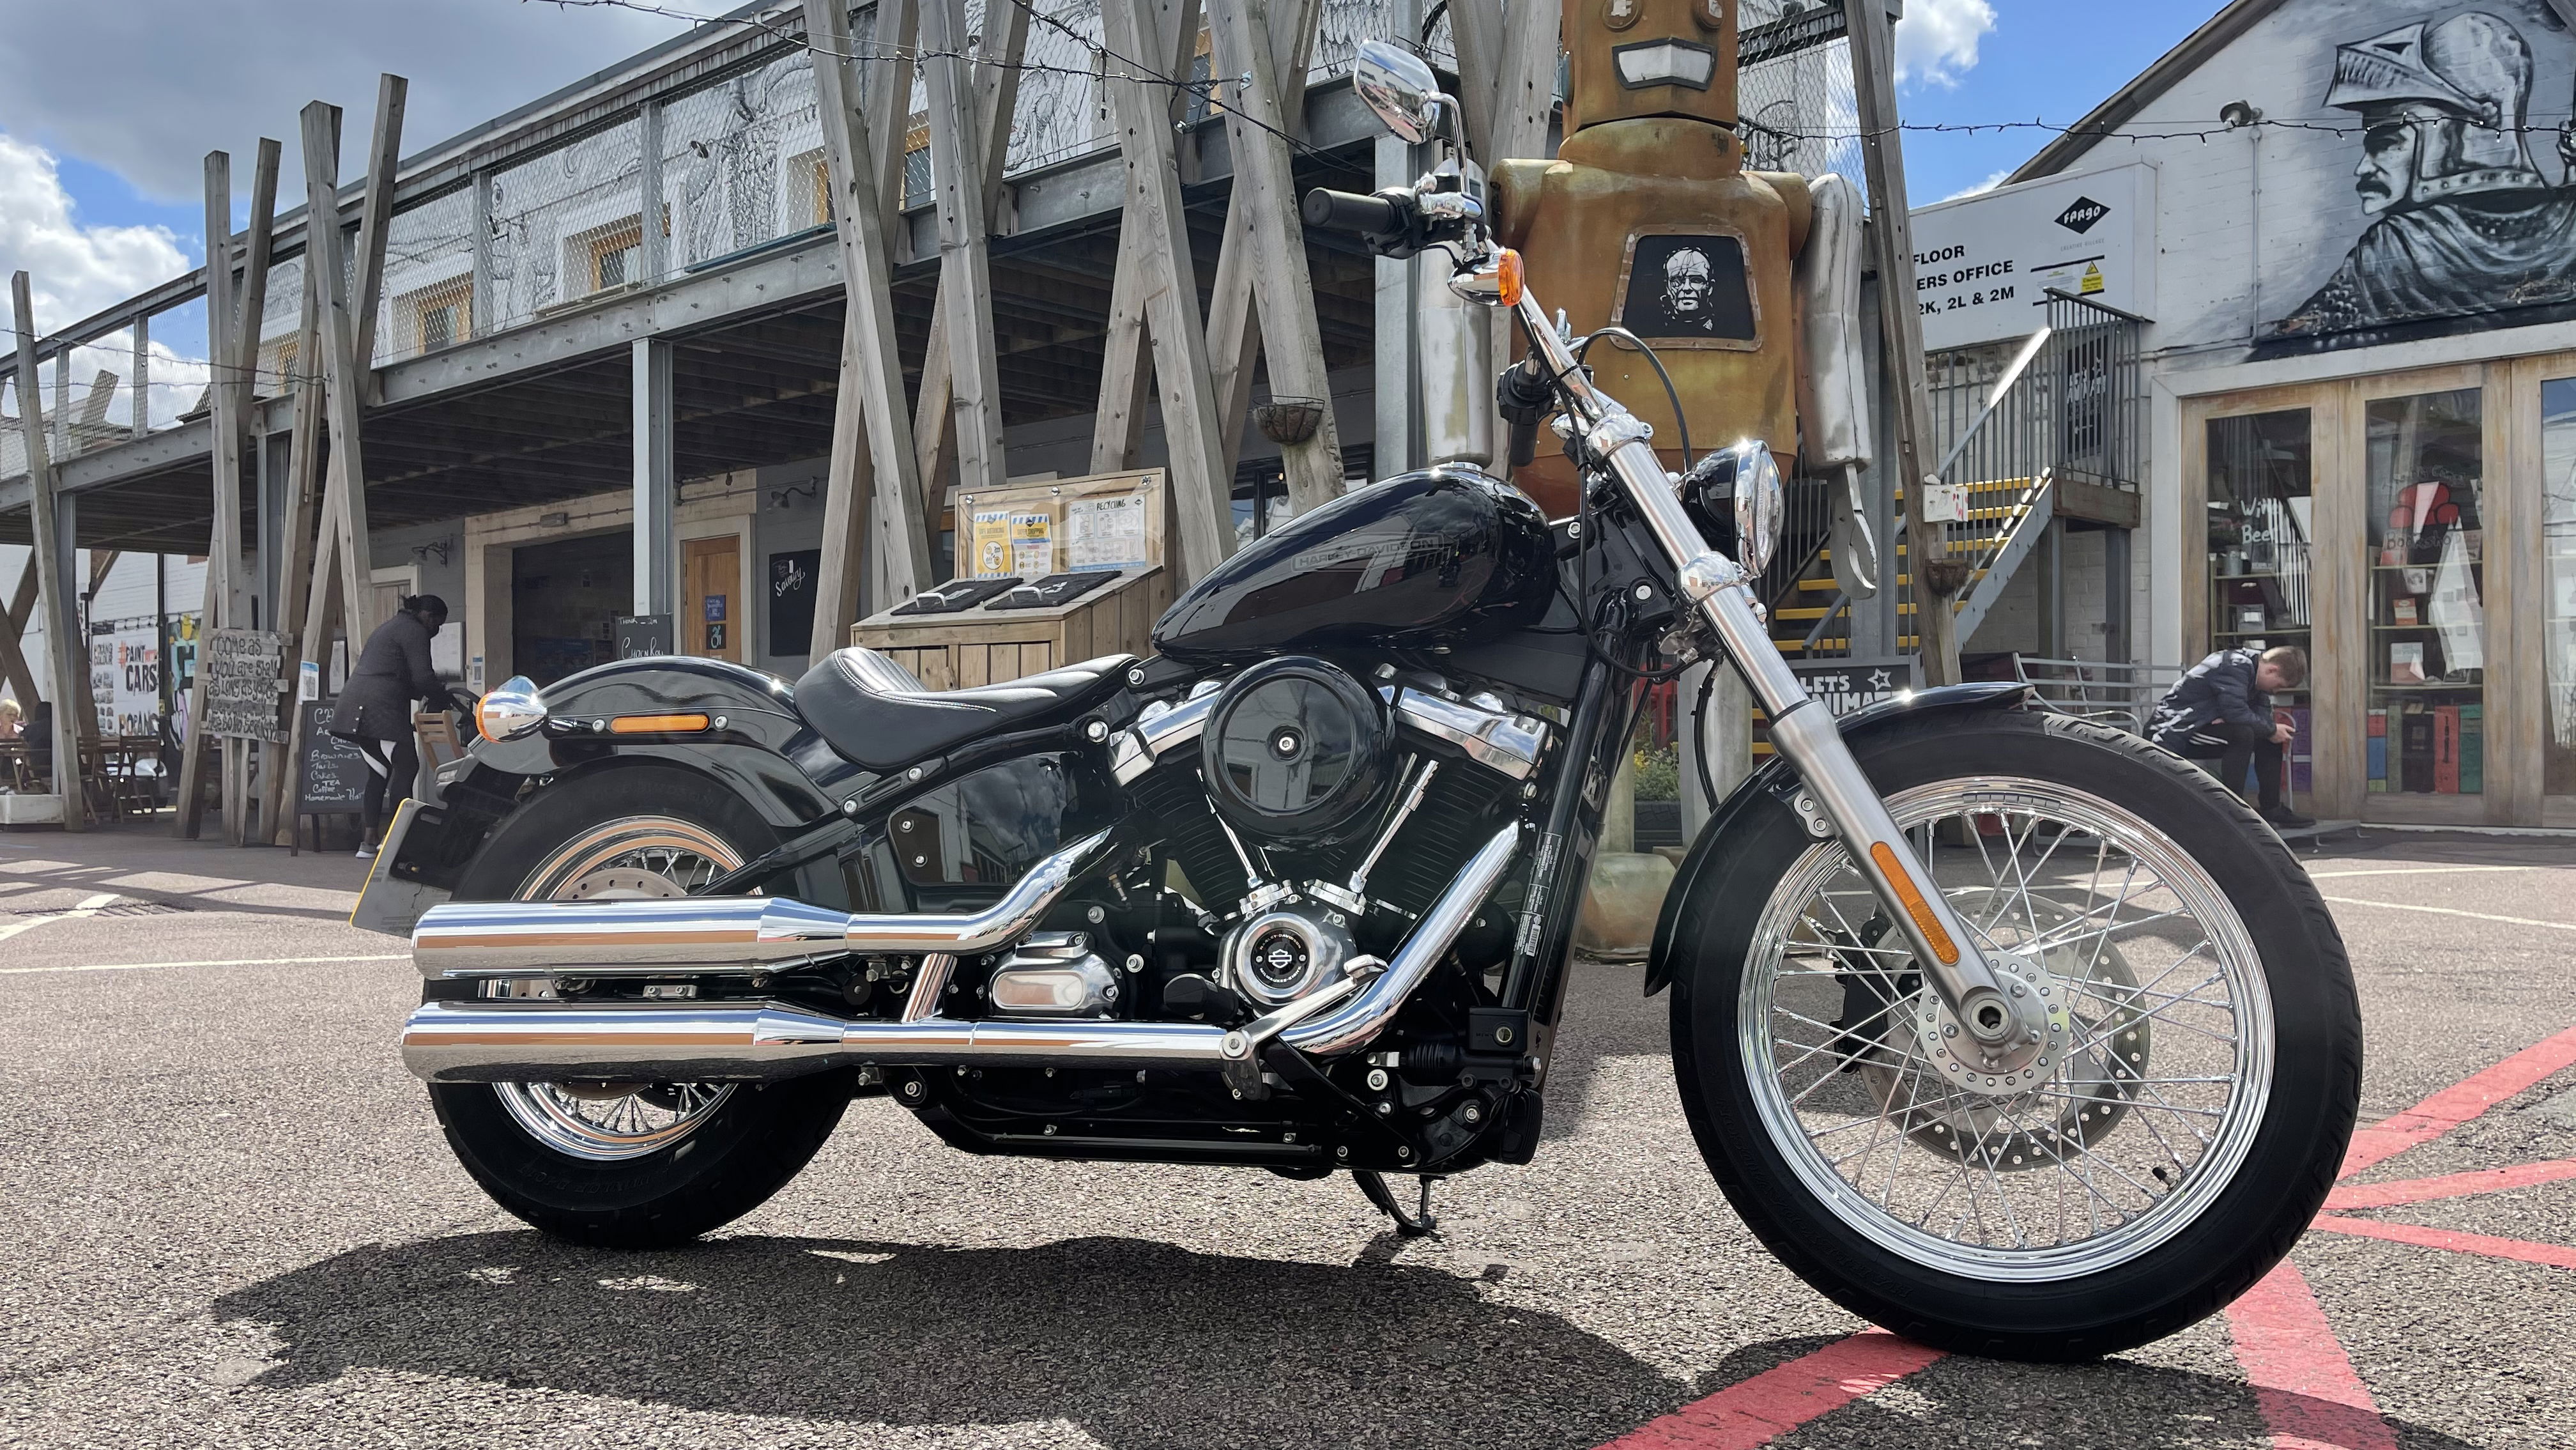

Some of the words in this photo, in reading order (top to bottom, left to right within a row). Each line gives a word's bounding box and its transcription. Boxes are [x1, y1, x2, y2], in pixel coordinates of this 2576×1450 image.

[1913, 245, 1965, 266] FLOOR
[1917, 274, 1947, 290] ERS
[1953, 260, 2013, 283] OFFICE
[1947, 296, 1966, 310] 2L
[1972, 292, 1984, 305] &
[1989, 286, 2014, 302] 2M
[1096, 499, 1126, 511] RECYCLING
[1299, 539, 1436, 567] HARLEY-DAVIDSON
[126, 664, 158, 693] CARS
[1800, 671, 1850, 693] LET'S
[1812, 691, 1903, 716] NIMAT
[1259, 934, 1302, 950] HARLEY-DAVIDSON
